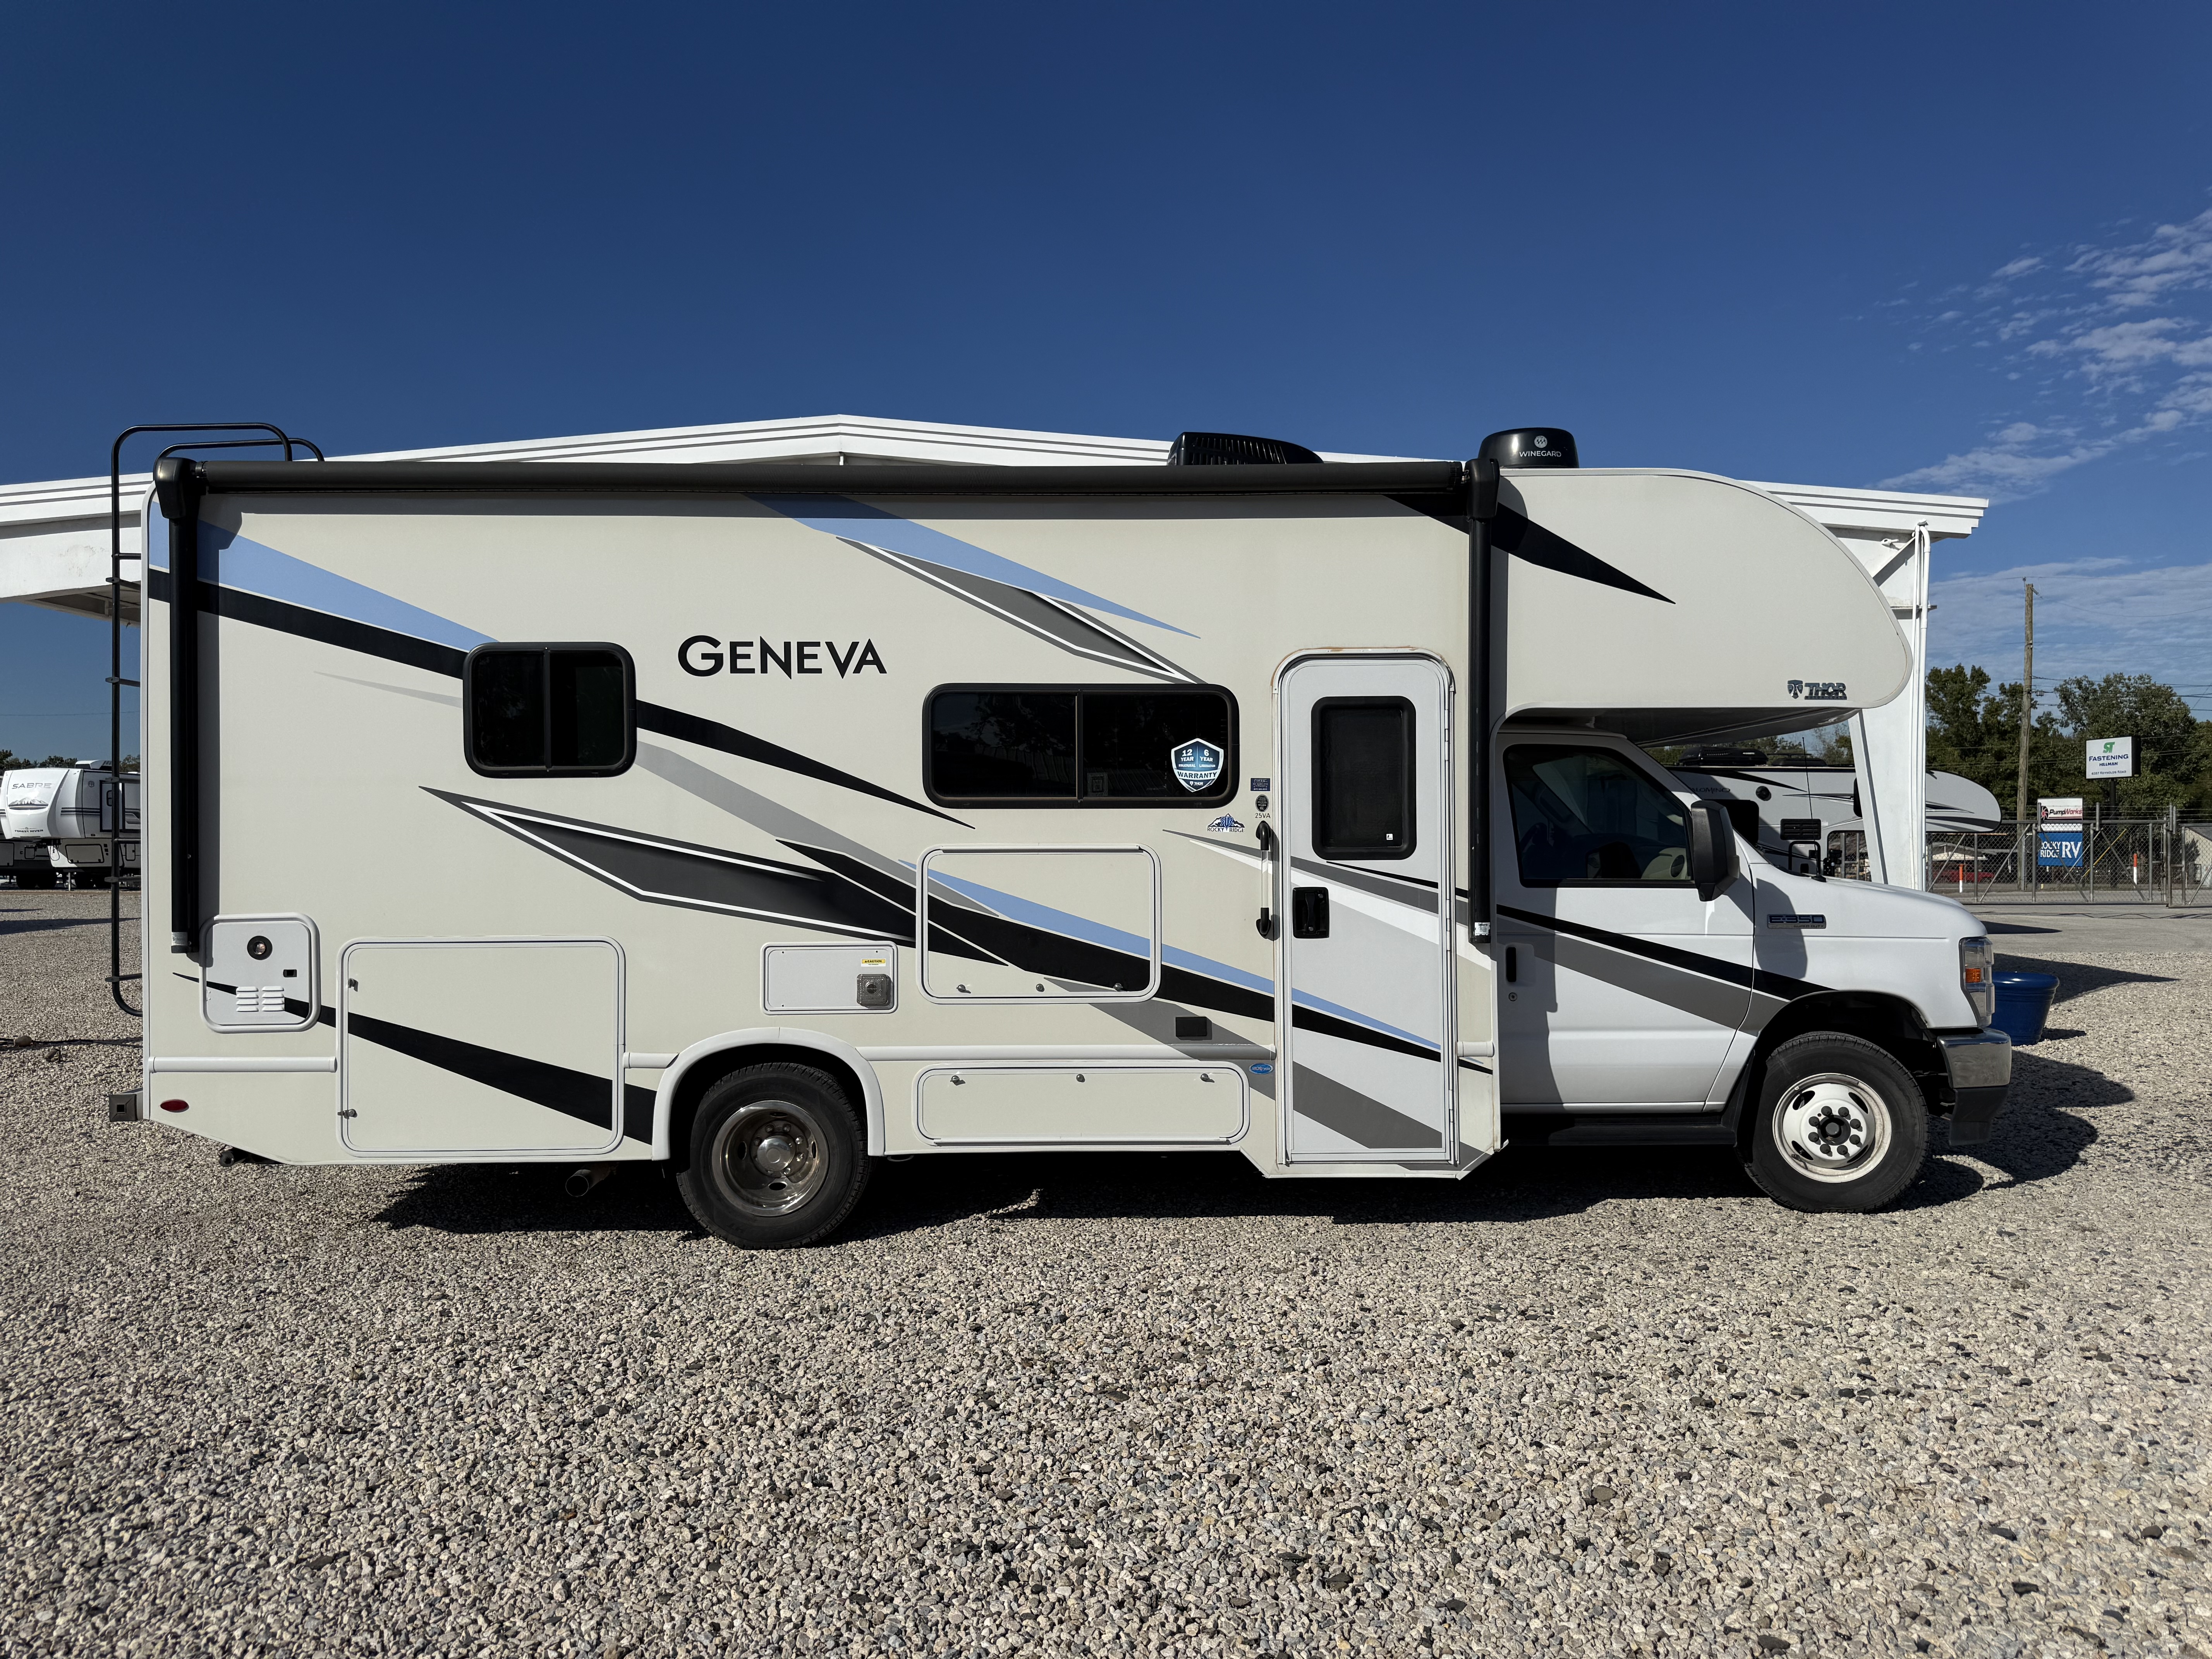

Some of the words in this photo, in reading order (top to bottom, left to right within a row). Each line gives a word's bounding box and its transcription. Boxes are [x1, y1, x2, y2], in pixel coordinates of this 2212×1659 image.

[678, 635, 887, 679] GENEVA
[1804, 683, 1846, 696] THOR
[2062, 842, 2082, 858] RV
[1769, 915, 1824, 923] E-350
